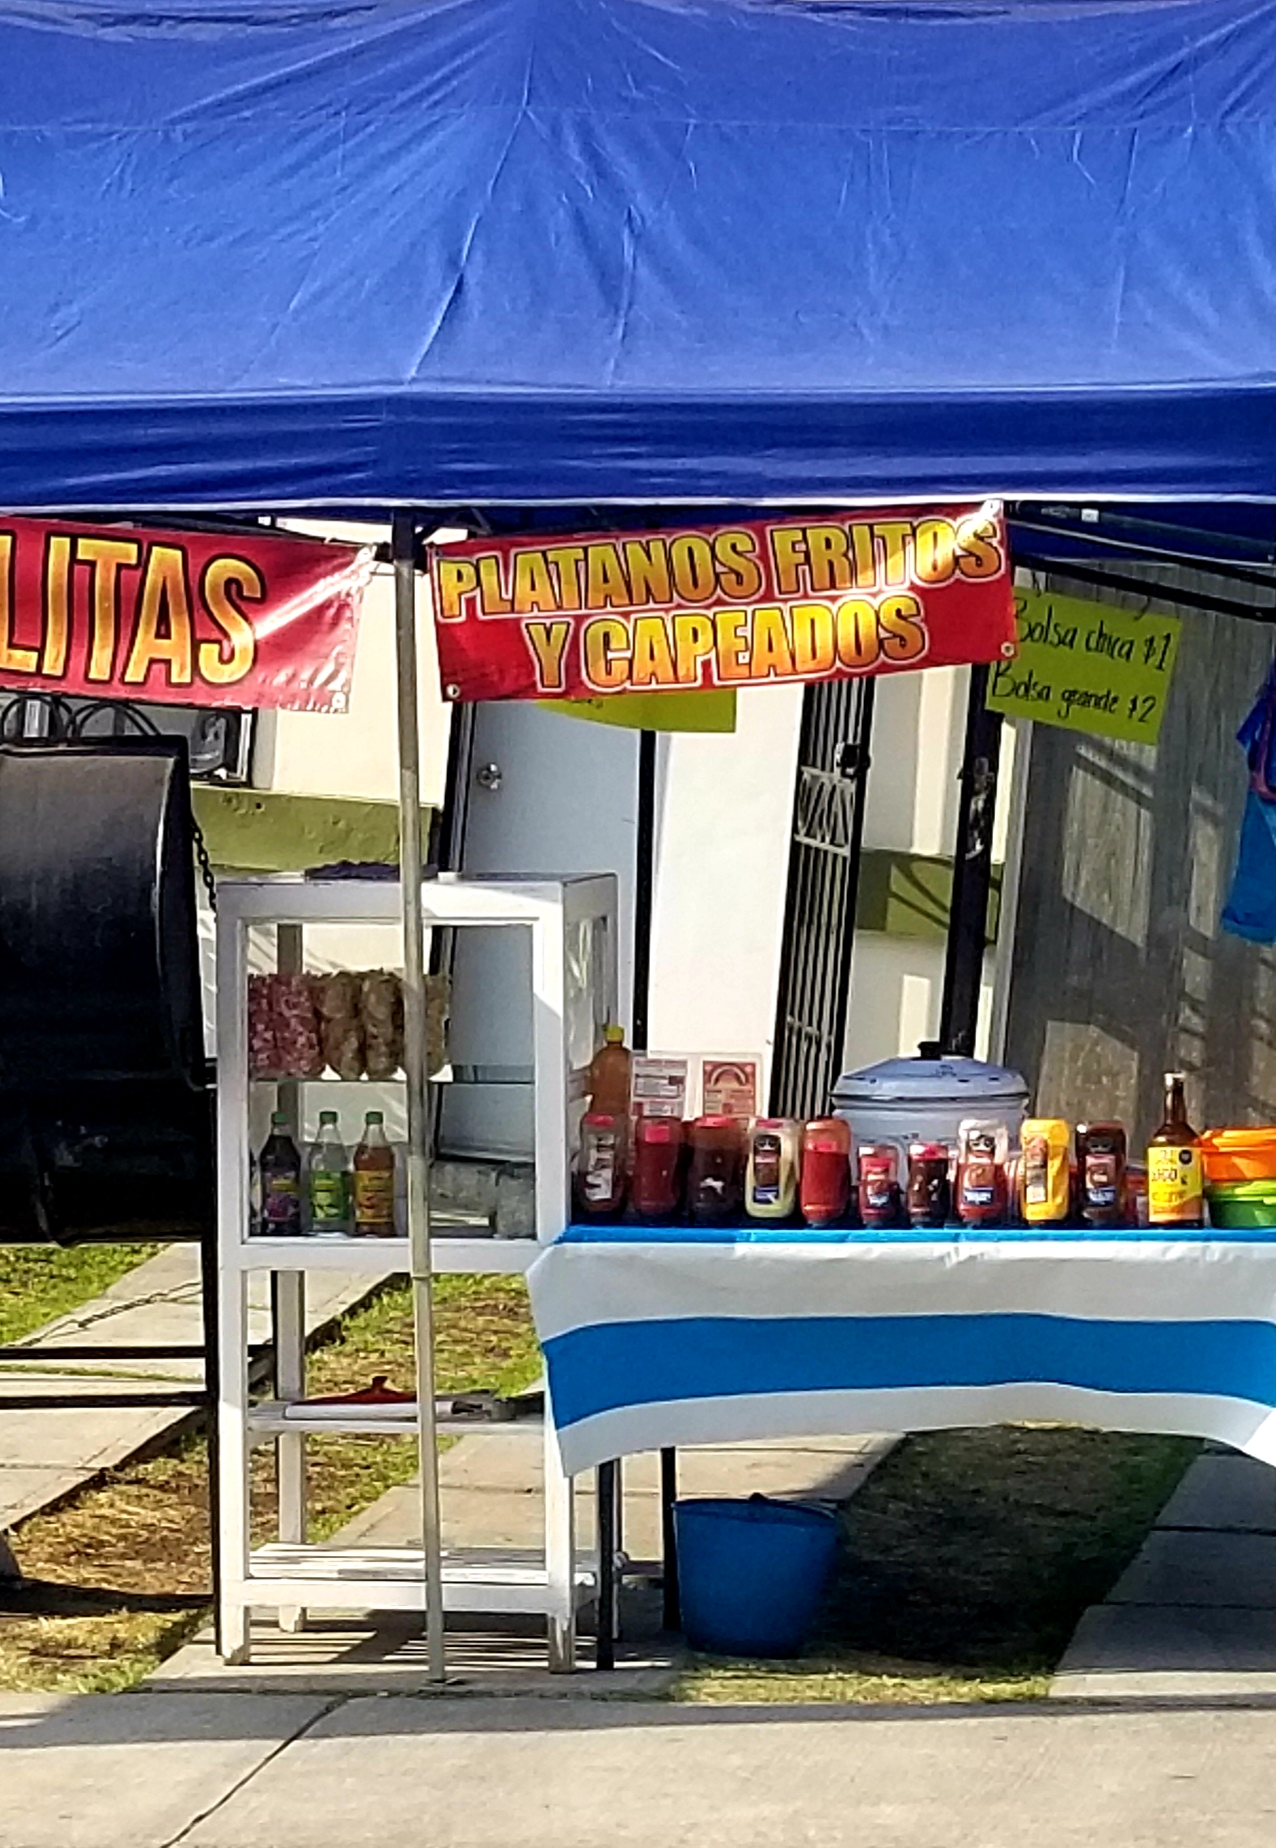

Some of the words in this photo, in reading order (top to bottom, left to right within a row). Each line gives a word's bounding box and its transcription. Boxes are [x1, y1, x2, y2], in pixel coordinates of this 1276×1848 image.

[439, 531, 763, 619] PLATANOS
[773, 518, 1002, 596] FRITOS
[525, 621, 570, 689] Y
[582, 594, 925, 685] CAPEADOS
[1015, 597, 1078, 650] Bolsa
[1086, 620, 1135, 662] chica
[1144, 632, 1171, 671] $1
[993, 661, 1051, 702] Bolsa
[1058, 687, 1119, 719] grande
[1128, 695, 1156, 723] $2
